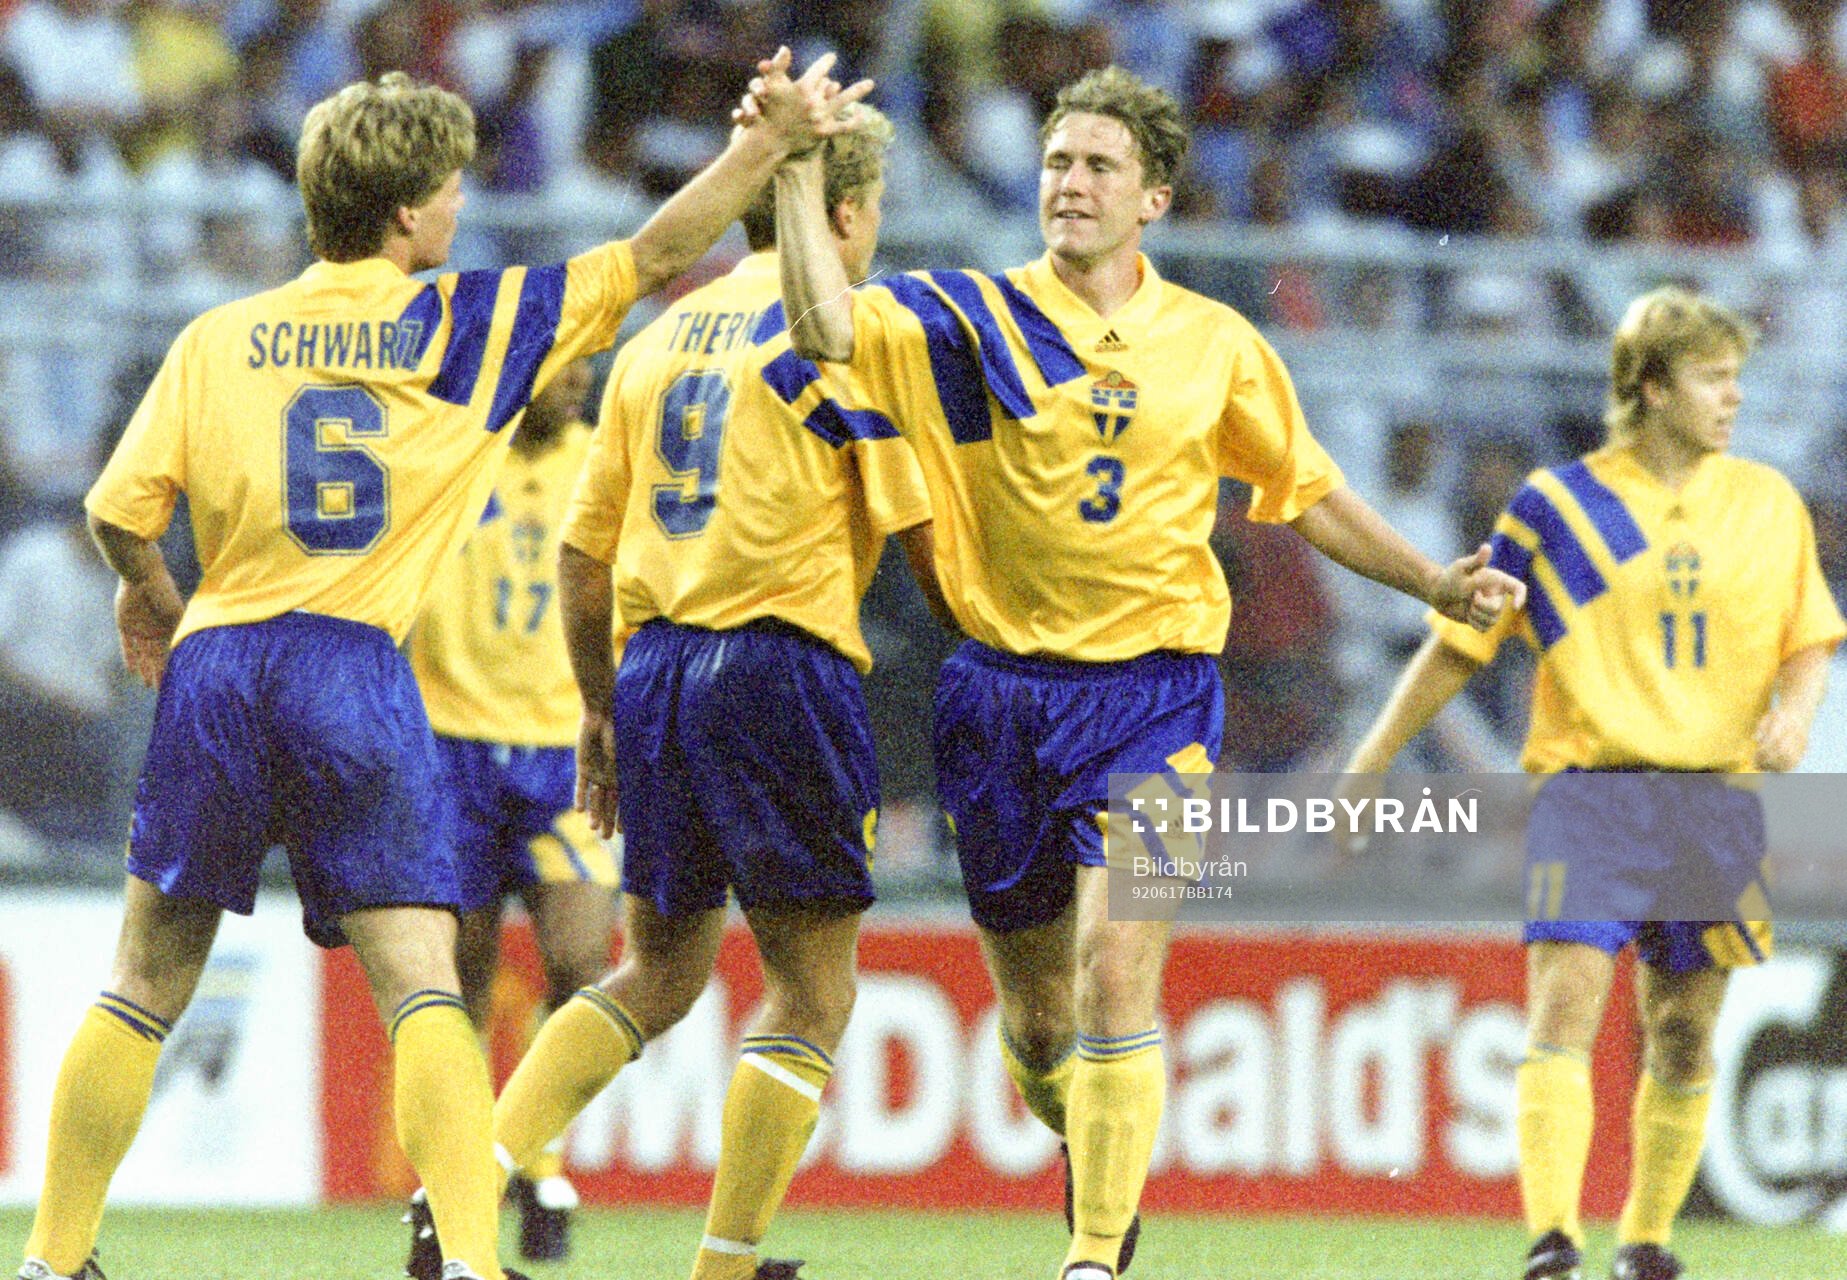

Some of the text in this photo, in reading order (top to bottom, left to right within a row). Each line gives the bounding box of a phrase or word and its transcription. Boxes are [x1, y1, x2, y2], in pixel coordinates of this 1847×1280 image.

[248, 319, 423, 372] SCHWARZ
[280, 383, 391, 557] 6
[650, 368, 733, 541] 9
[1078, 455, 1126, 524] 3
[492, 574, 553, 634] 17
[1659, 611, 1707, 670] 11
